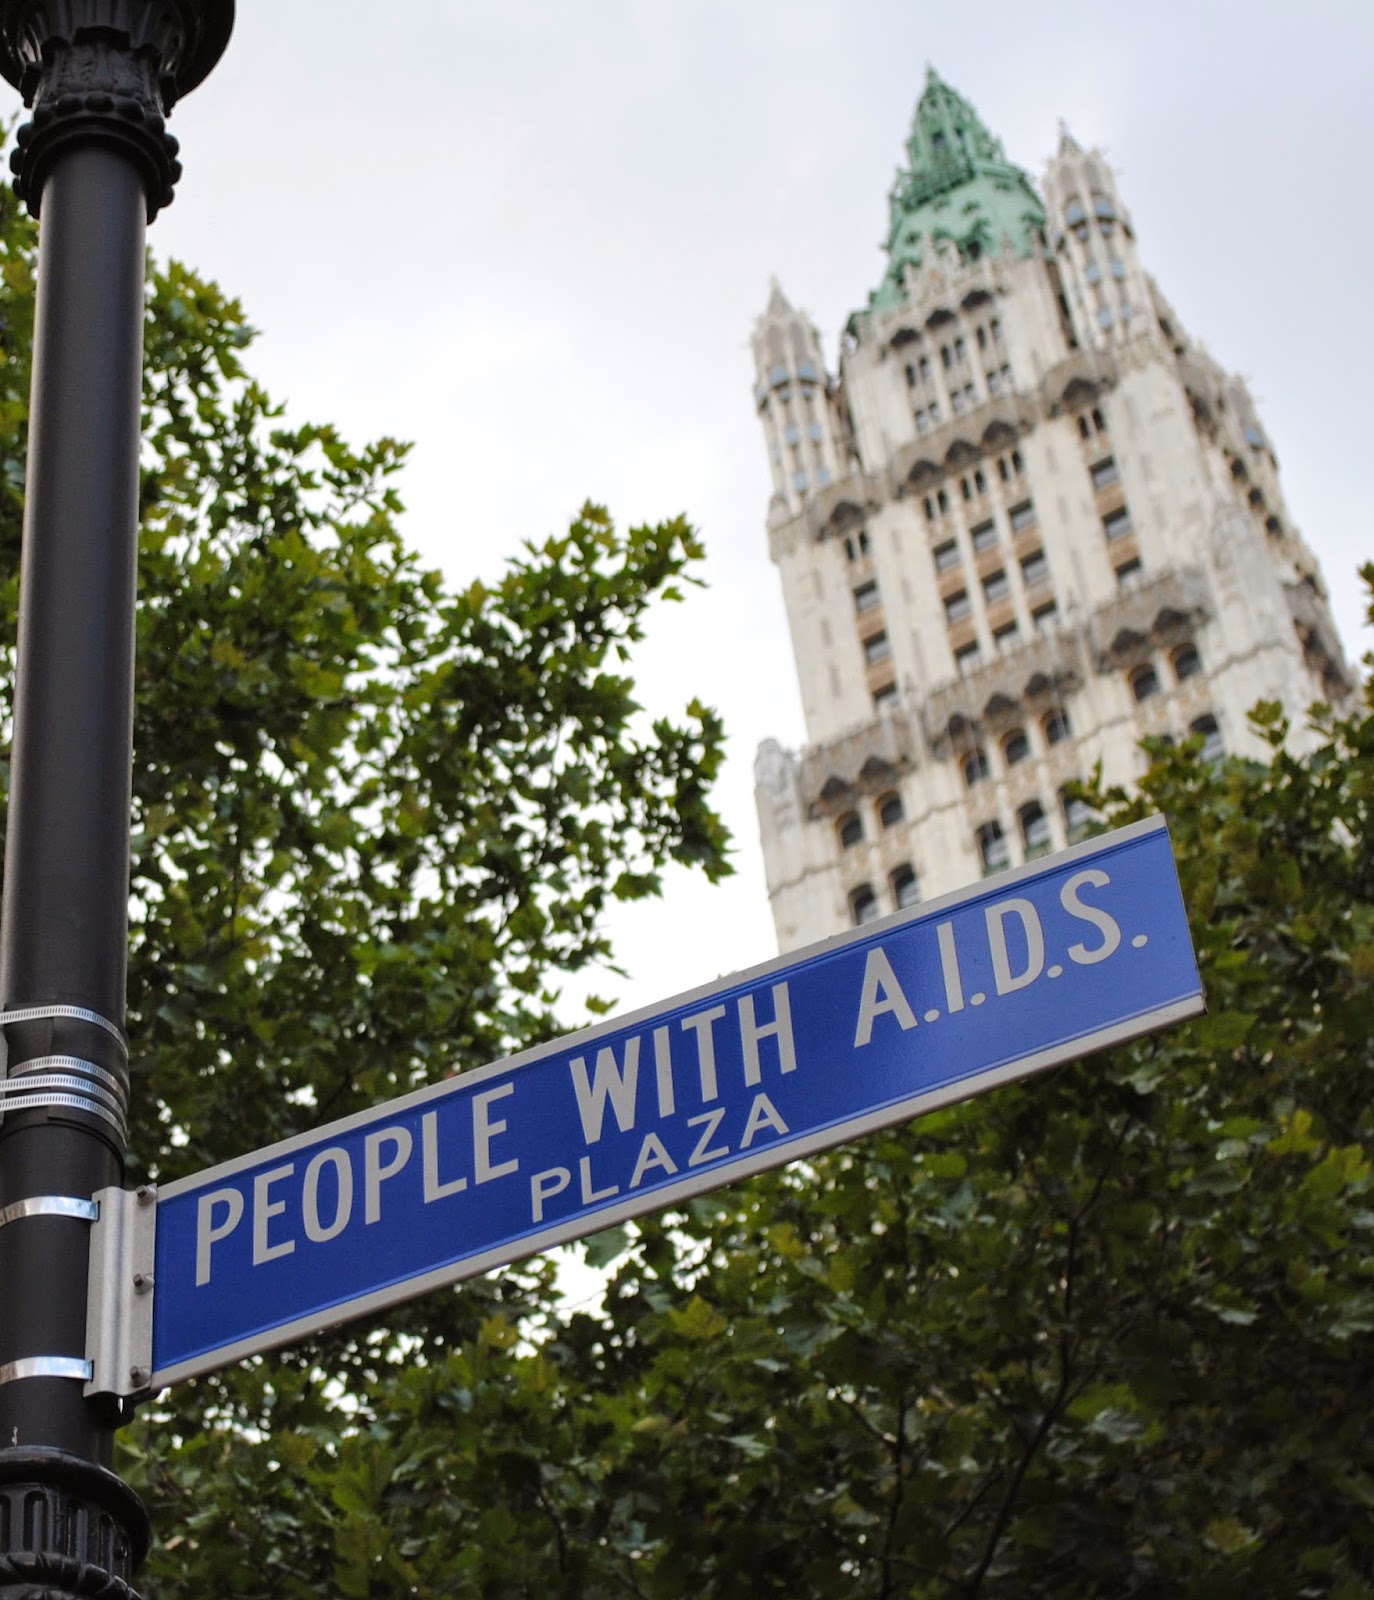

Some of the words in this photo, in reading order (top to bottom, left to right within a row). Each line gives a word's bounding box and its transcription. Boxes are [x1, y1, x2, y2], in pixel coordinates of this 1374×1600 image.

[195, 1082, 520, 1287] PEOPLE
[568, 981, 798, 1145] WITH
[853, 868, 1149, 1048] A.I.D.S.
[530, 1092, 790, 1222] PLAZA
